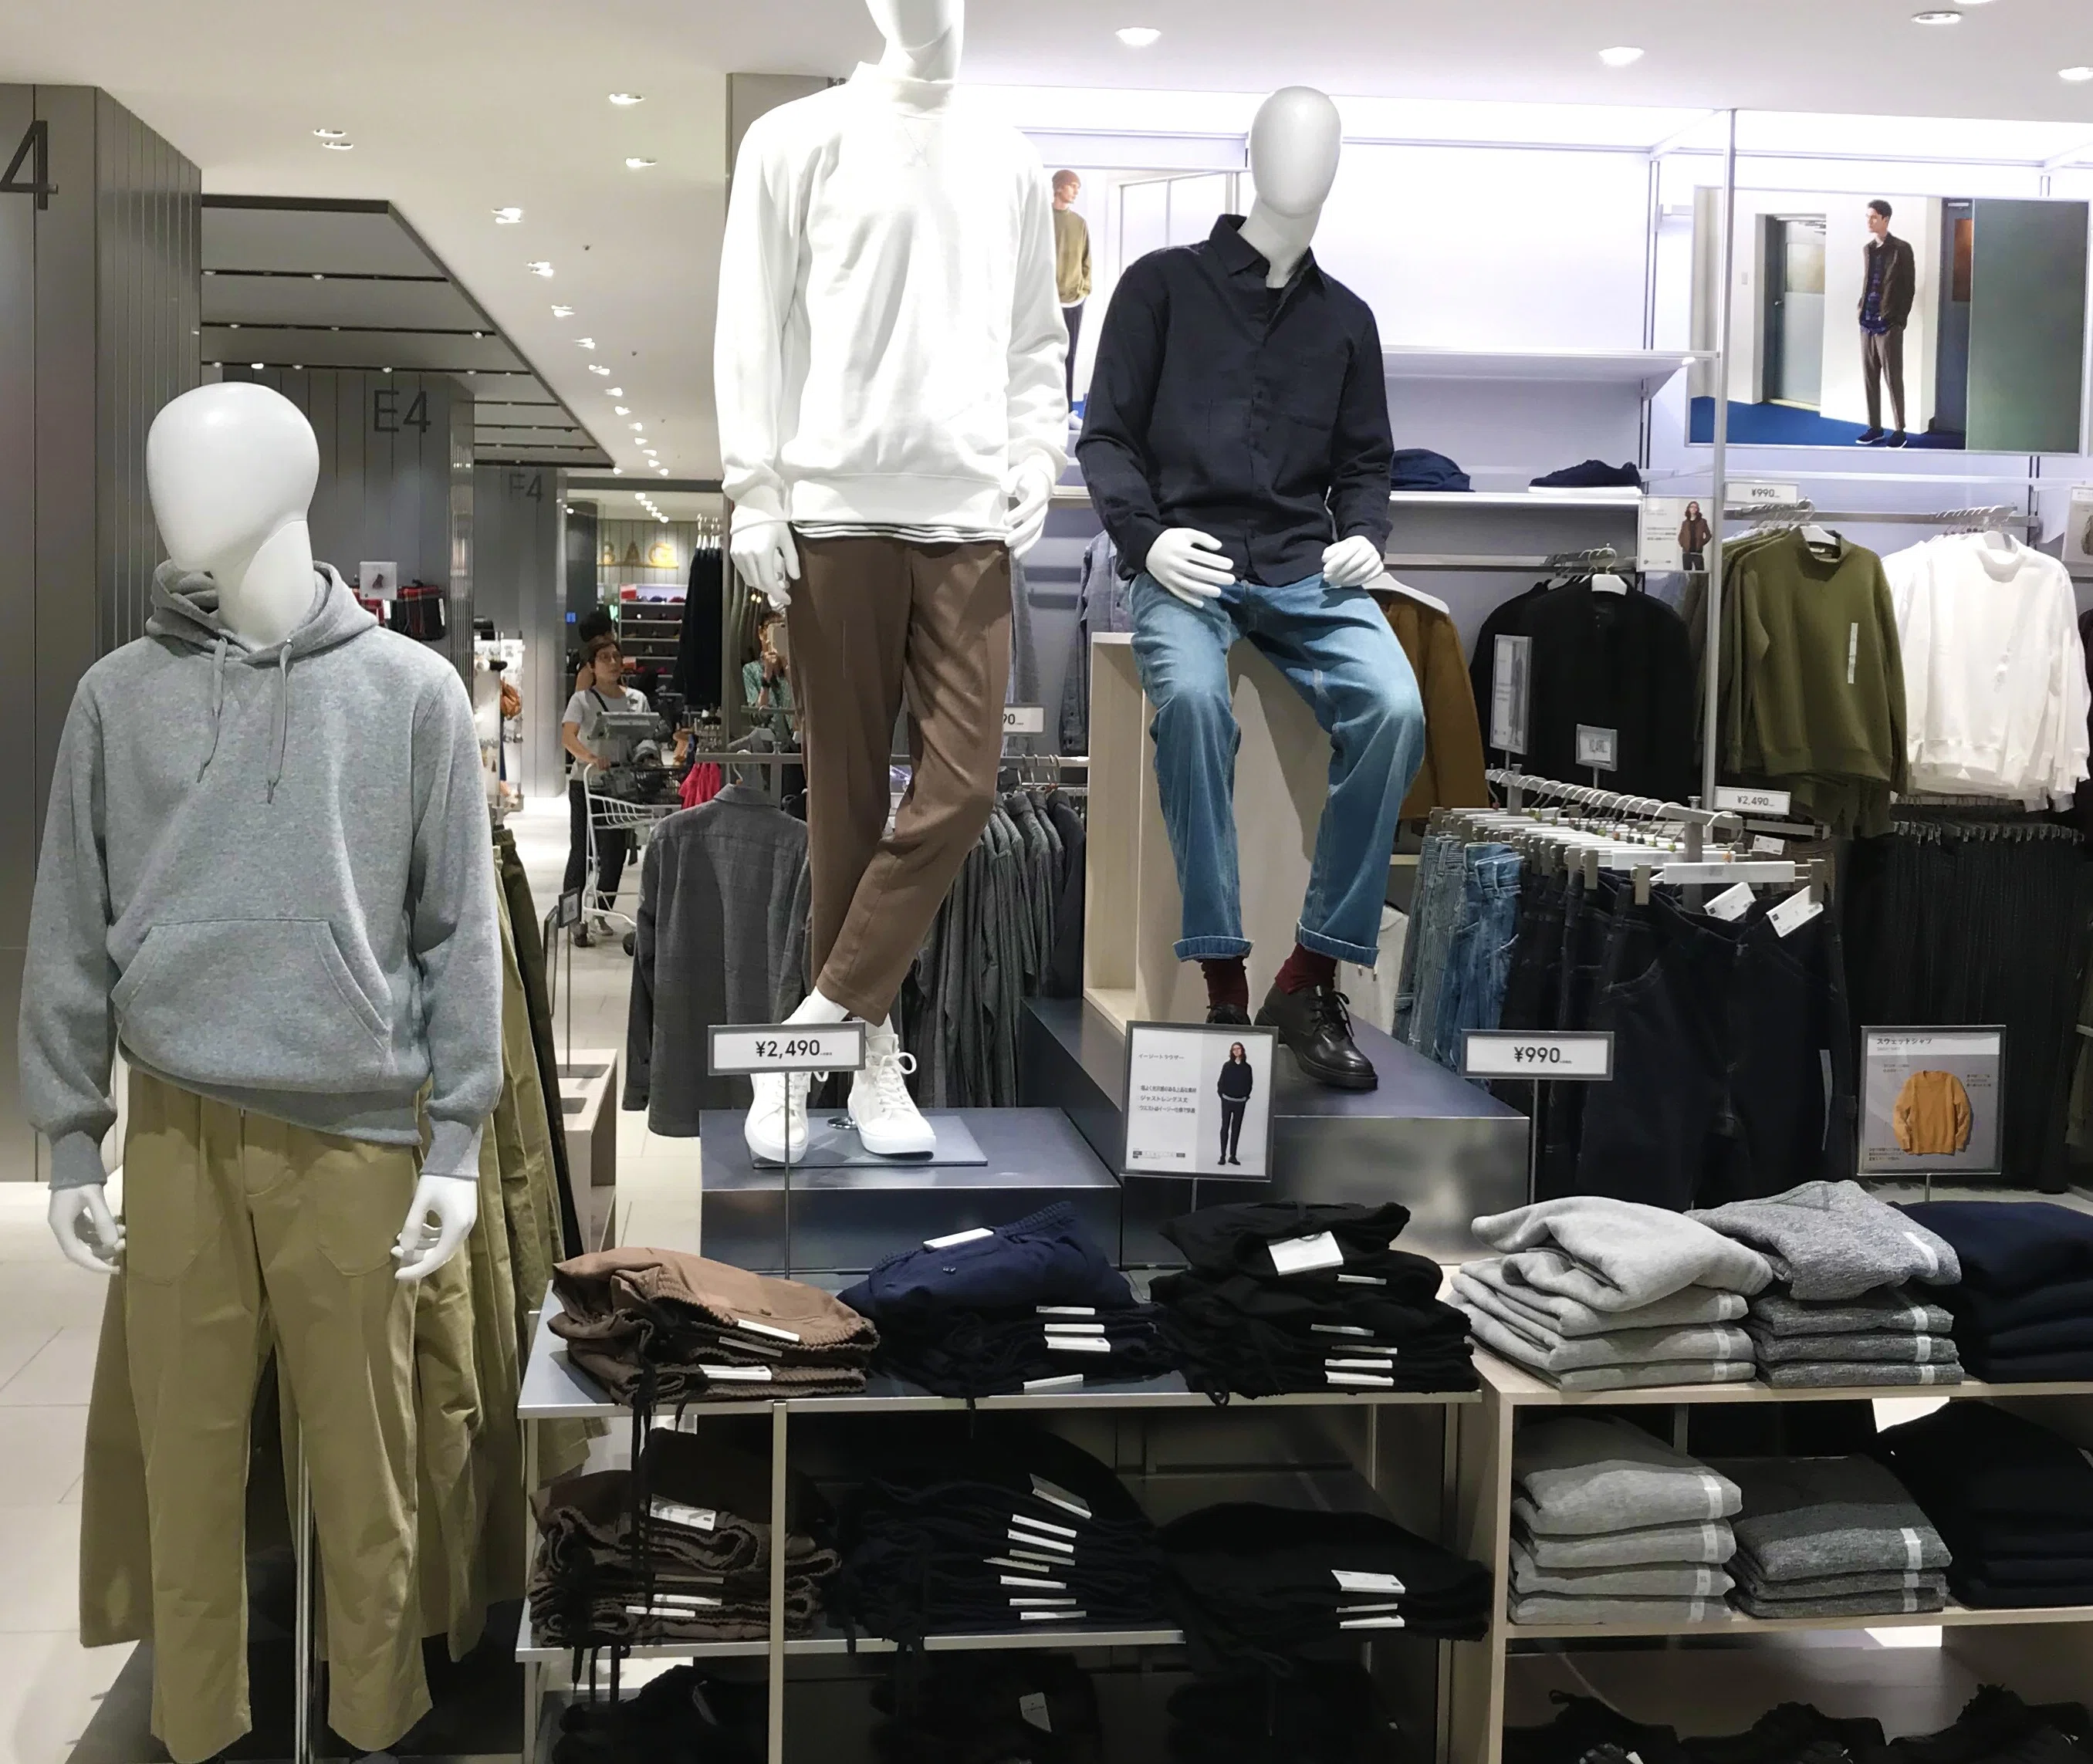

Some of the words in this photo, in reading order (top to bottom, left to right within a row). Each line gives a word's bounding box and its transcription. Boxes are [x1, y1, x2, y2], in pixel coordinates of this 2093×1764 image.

[0, 120, 58, 210] 4
[374, 390, 431, 432] E4
[509, 473, 543, 502] F4
[1751, 488, 1775, 498] ¥990
[601, 541, 676, 566] BAG
[1737, 796, 1770, 806] ¥2,490
[756, 1039, 820, 1059] ¥2,490
[1514, 1046, 1560, 1063] ¥990
